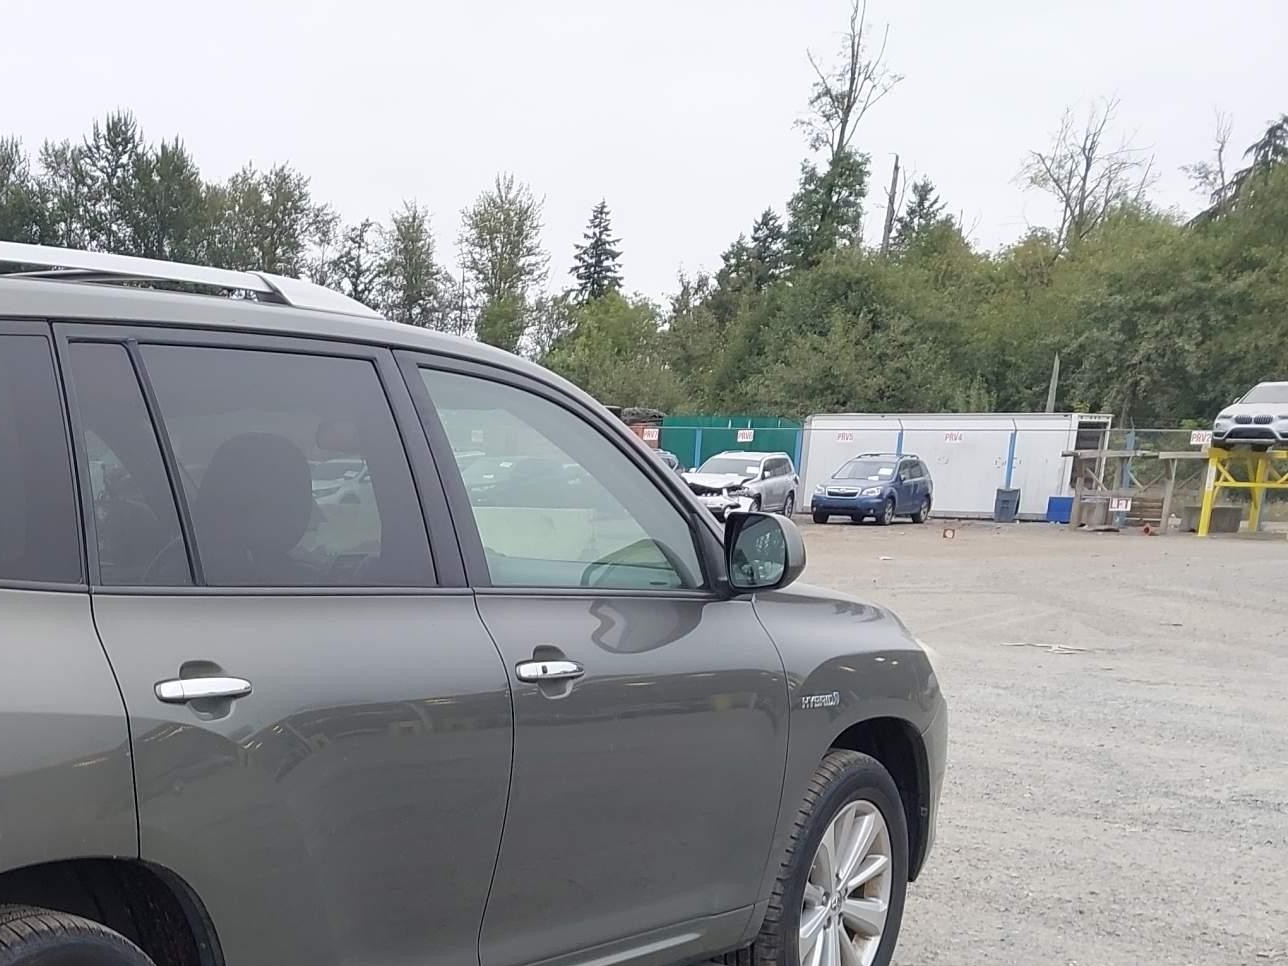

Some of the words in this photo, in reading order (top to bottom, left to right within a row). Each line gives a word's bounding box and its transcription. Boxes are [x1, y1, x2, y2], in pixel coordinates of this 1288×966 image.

[837, 432, 854, 441] PRV5
[945, 432, 963, 441] PRV4
[1192, 432, 1212, 442] PRV2
